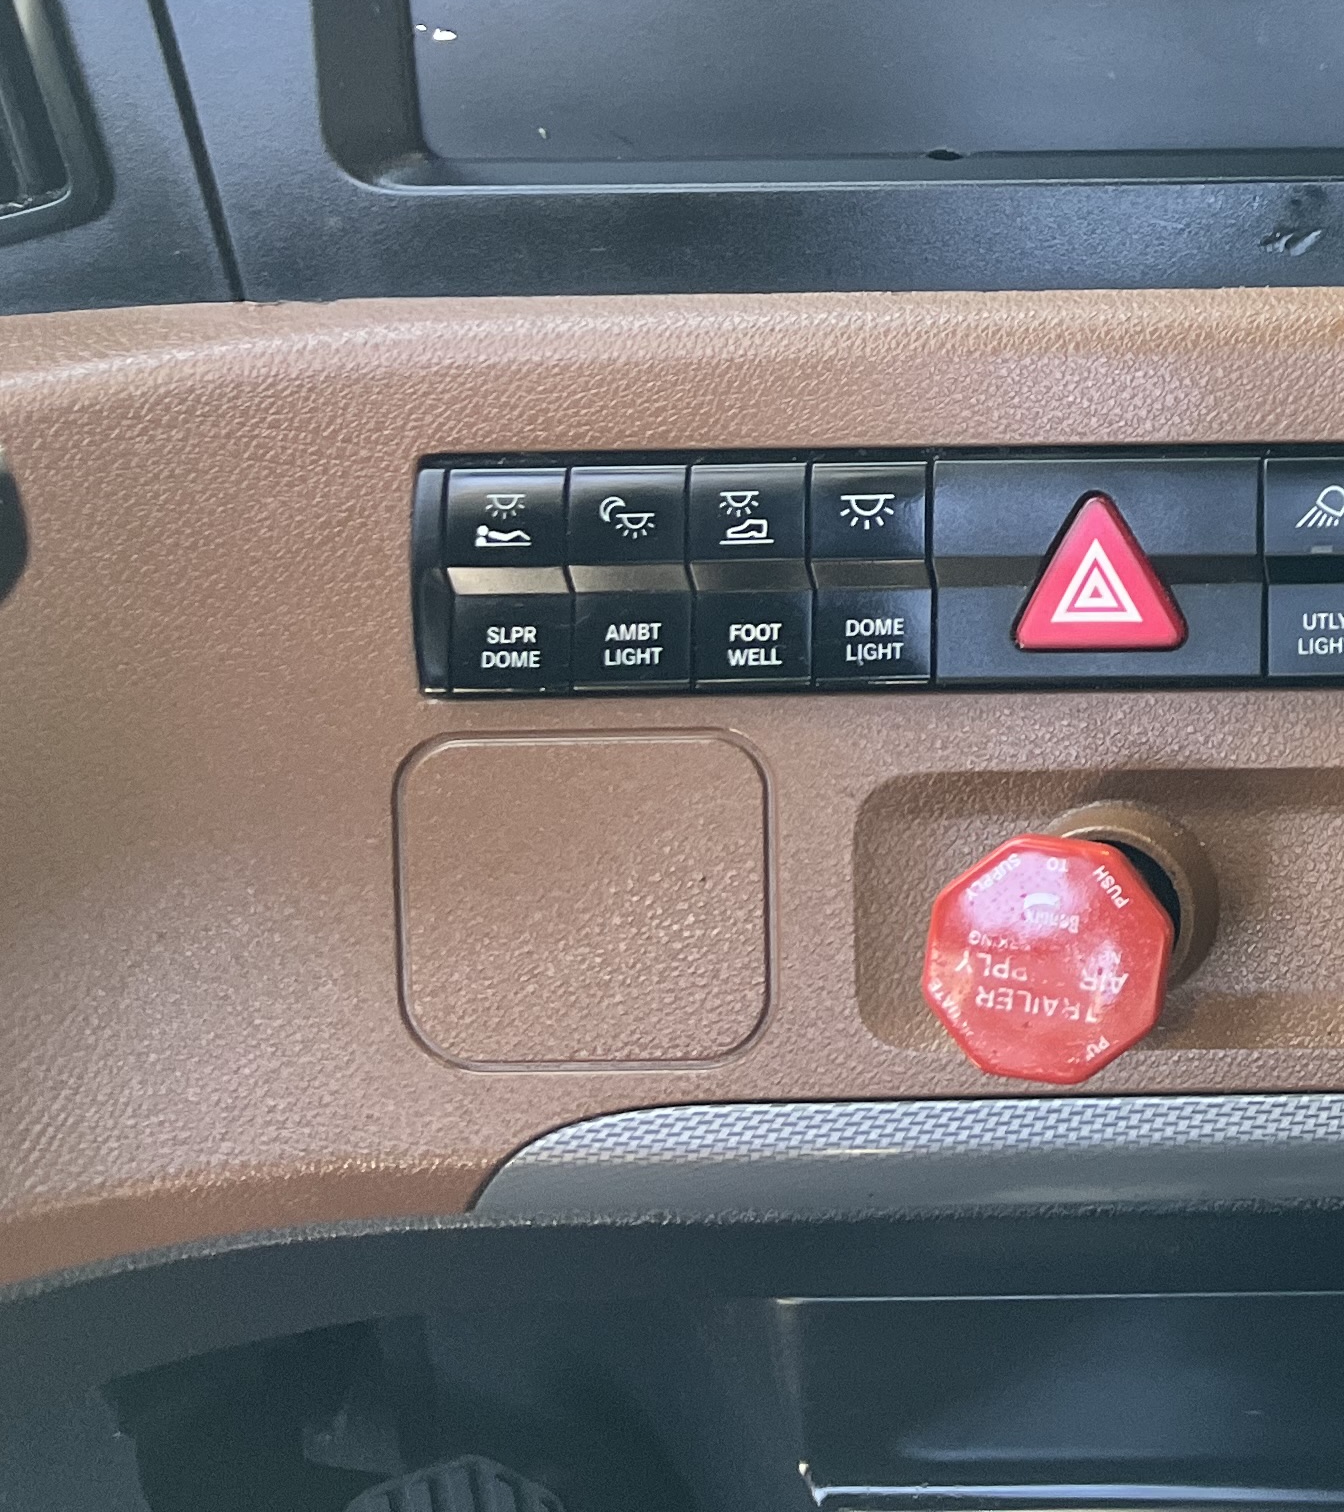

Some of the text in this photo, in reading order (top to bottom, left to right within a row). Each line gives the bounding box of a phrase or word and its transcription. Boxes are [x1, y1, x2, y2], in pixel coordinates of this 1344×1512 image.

[487, 627, 536, 643] SLPR
[606, 623, 661, 641] AMBT
[730, 624, 781, 641] FOOT
[846, 618, 904, 636] DOME
[482, 651, 540, 667] DOME
[605, 648, 663, 665] LIGHT
[728, 648, 782, 666] WELL
[847, 643, 904, 662] LIGHT
[964, 853, 1130, 909] PUSH TO SUPPLY
[1079, 969, 1129, 995] AIR
